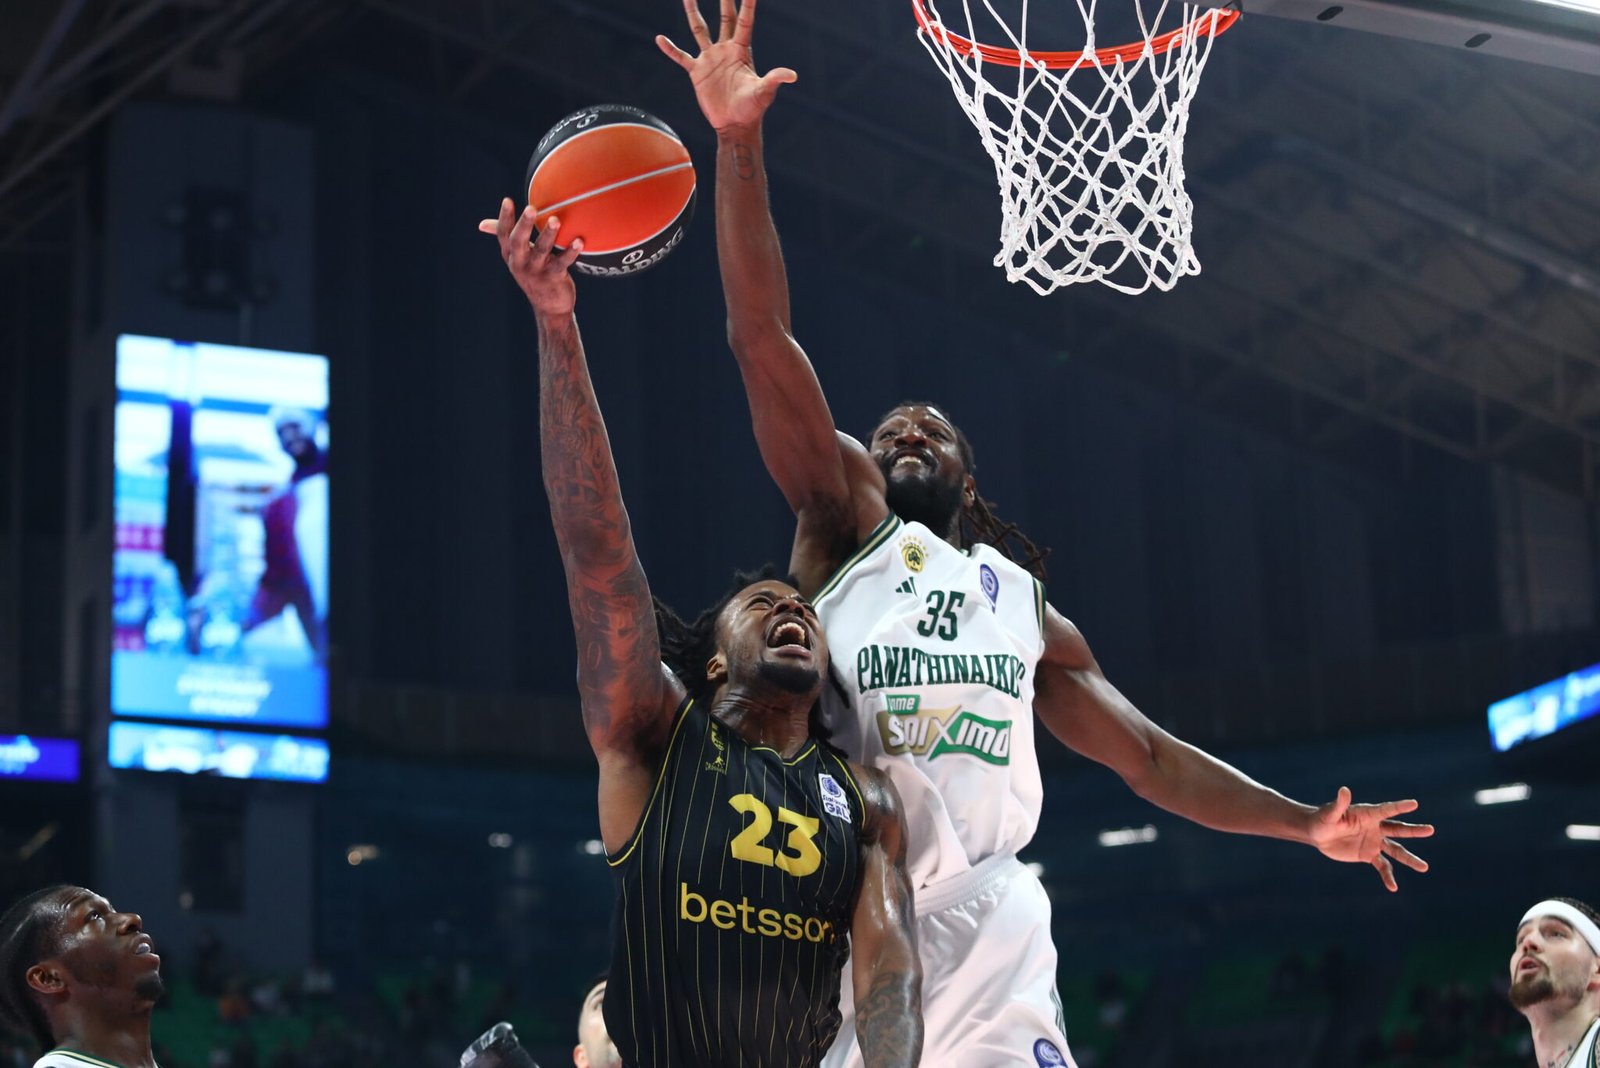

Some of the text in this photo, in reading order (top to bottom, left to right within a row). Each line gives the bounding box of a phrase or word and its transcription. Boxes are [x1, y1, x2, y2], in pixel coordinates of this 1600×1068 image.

[575, 226, 684, 276] SPALDING
[917, 590, 965, 641] 35
[888, 697, 915, 711] ame
[728, 793, 821, 877] 23
